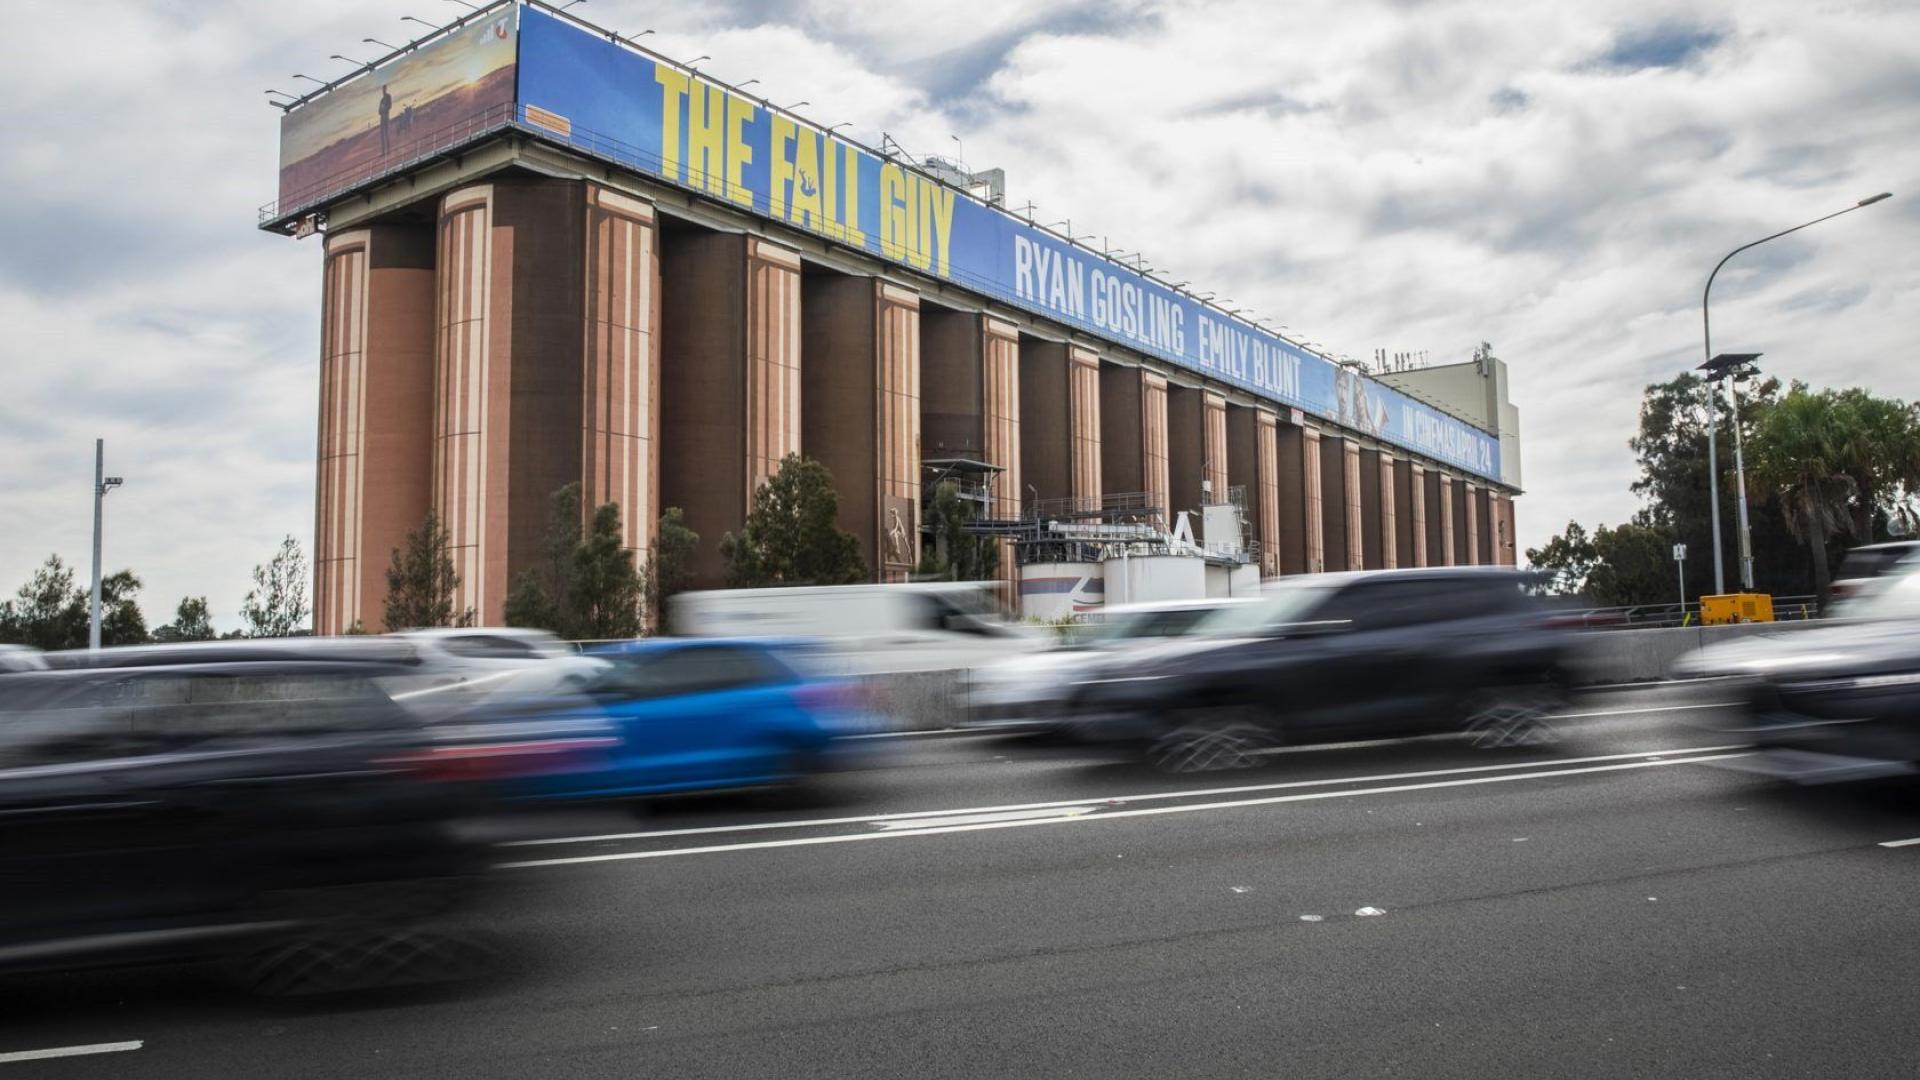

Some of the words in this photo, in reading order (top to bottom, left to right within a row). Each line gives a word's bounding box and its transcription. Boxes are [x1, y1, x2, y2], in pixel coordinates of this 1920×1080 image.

[655, 62, 754, 208] THE
[770, 113, 865, 247] FALL
[880, 162, 954, 278] GUY
[1015, 234, 1084, 321] RYAN
[1091, 268, 1184, 357] GOSLING
[1199, 314, 1248, 381] EMILY
[1253, 338, 1302, 401] BLUNT
[1402, 404, 1414, 442] IN
[1415, 410, 1456, 459] CINEMAS
[1456, 428, 1479, 472] APRIL
[1480, 438, 1492, 475] 24
